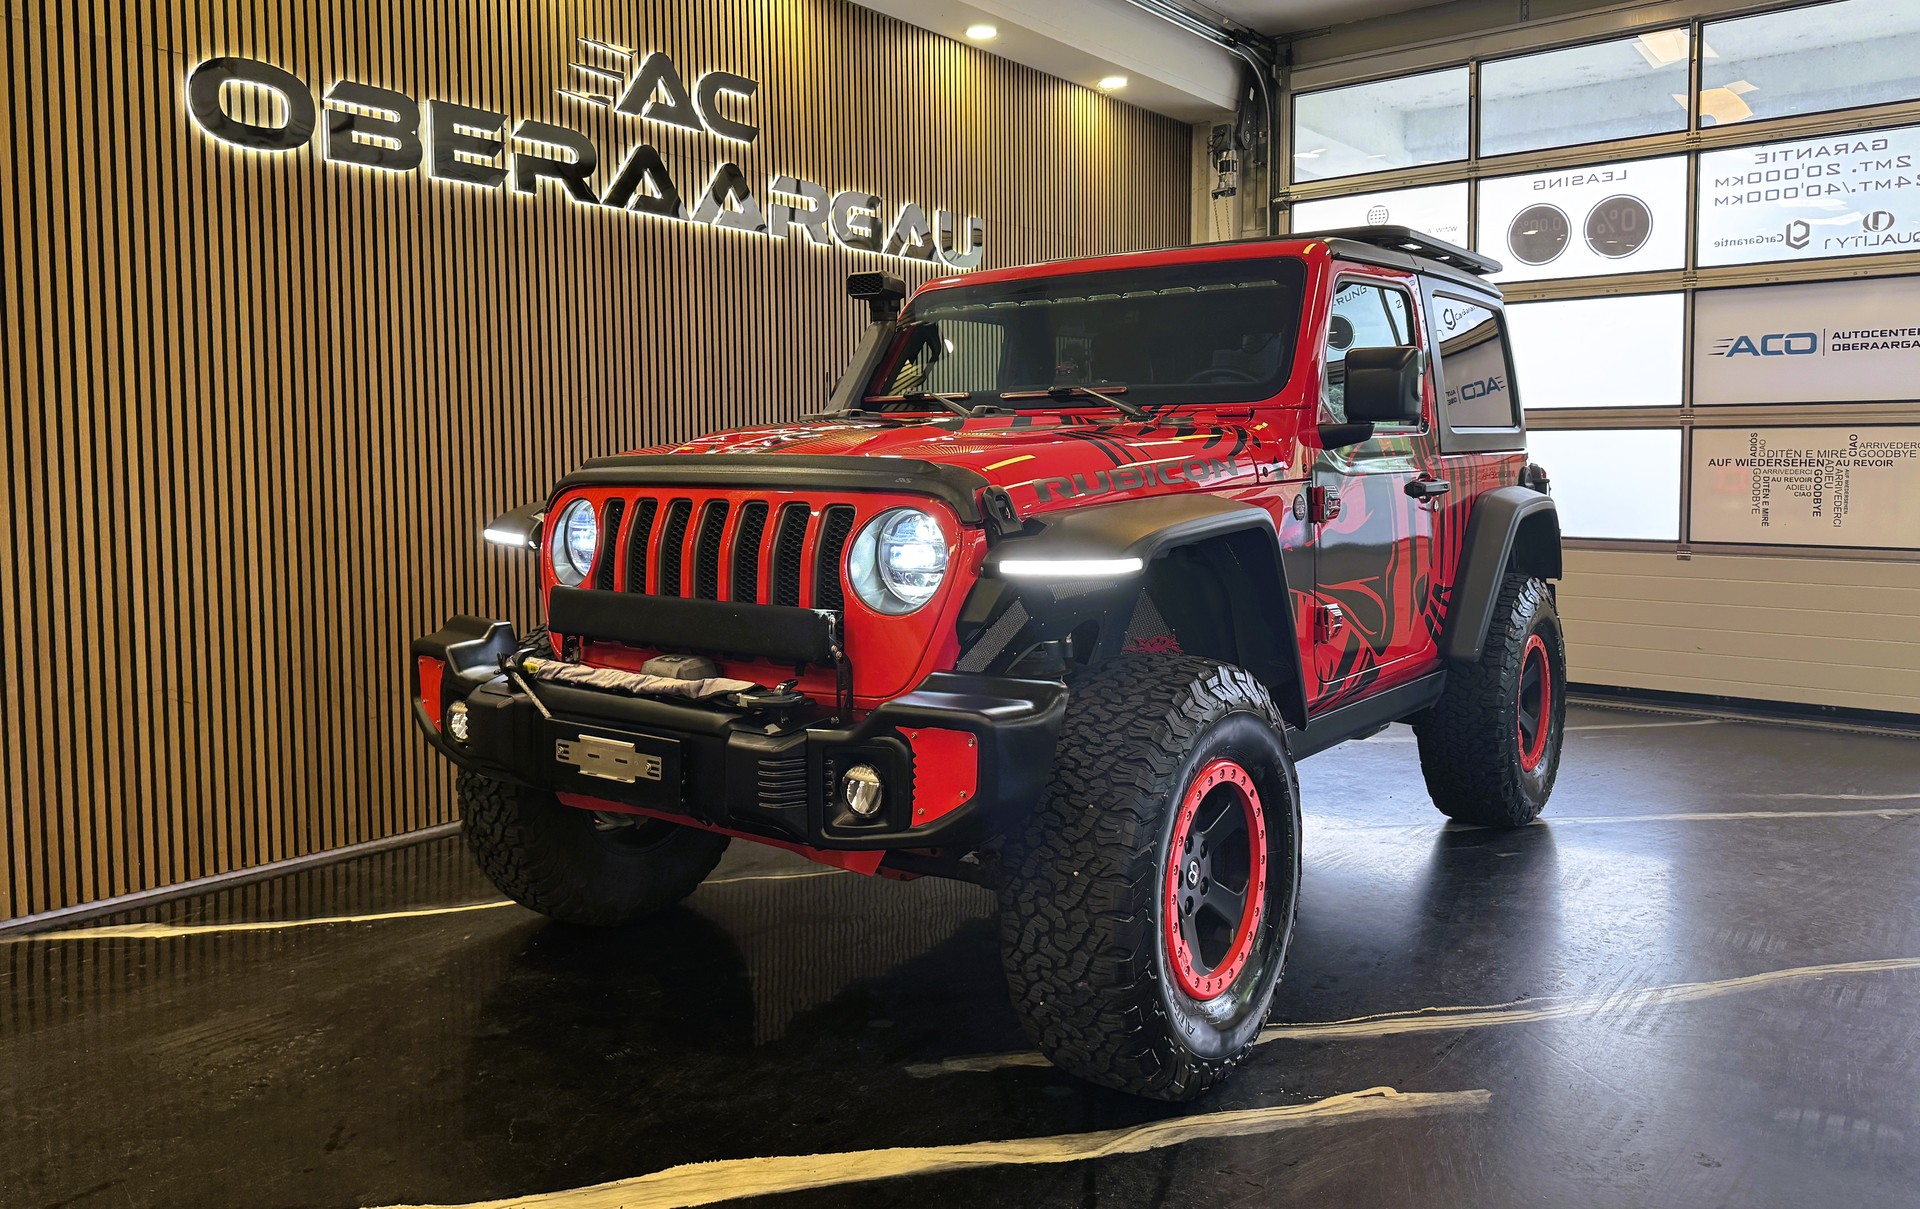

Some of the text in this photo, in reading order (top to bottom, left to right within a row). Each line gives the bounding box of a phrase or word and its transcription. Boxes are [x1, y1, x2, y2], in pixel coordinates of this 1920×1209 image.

[188, 55, 984, 267] OBERAARGAU
[1725, 332, 1818, 357] ACO
[1832, 328, 1920, 339] AUTOCENTE
[1750, 432, 1758, 457] ADIÓS
[1758, 439, 1766, 457] CIAO
[1767, 448, 1847, 458] DITËN E MIRË
[1849, 433, 1858, 457] CIAO
[1858, 450, 1917, 458] GOODBYE
[1708, 458, 1825, 467] AUF WIEDERSEHEN
[1824, 459, 1834, 489] ADIEU
[1835, 459, 1894, 467] AU REVOIR
[1032, 455, 1238, 502] RUBICON
[1752, 468, 1762, 514] GOODBYE
[1812, 469, 1822, 517] GOODBYE
[1833, 468, 1843, 528] ARRIVEDERCI
